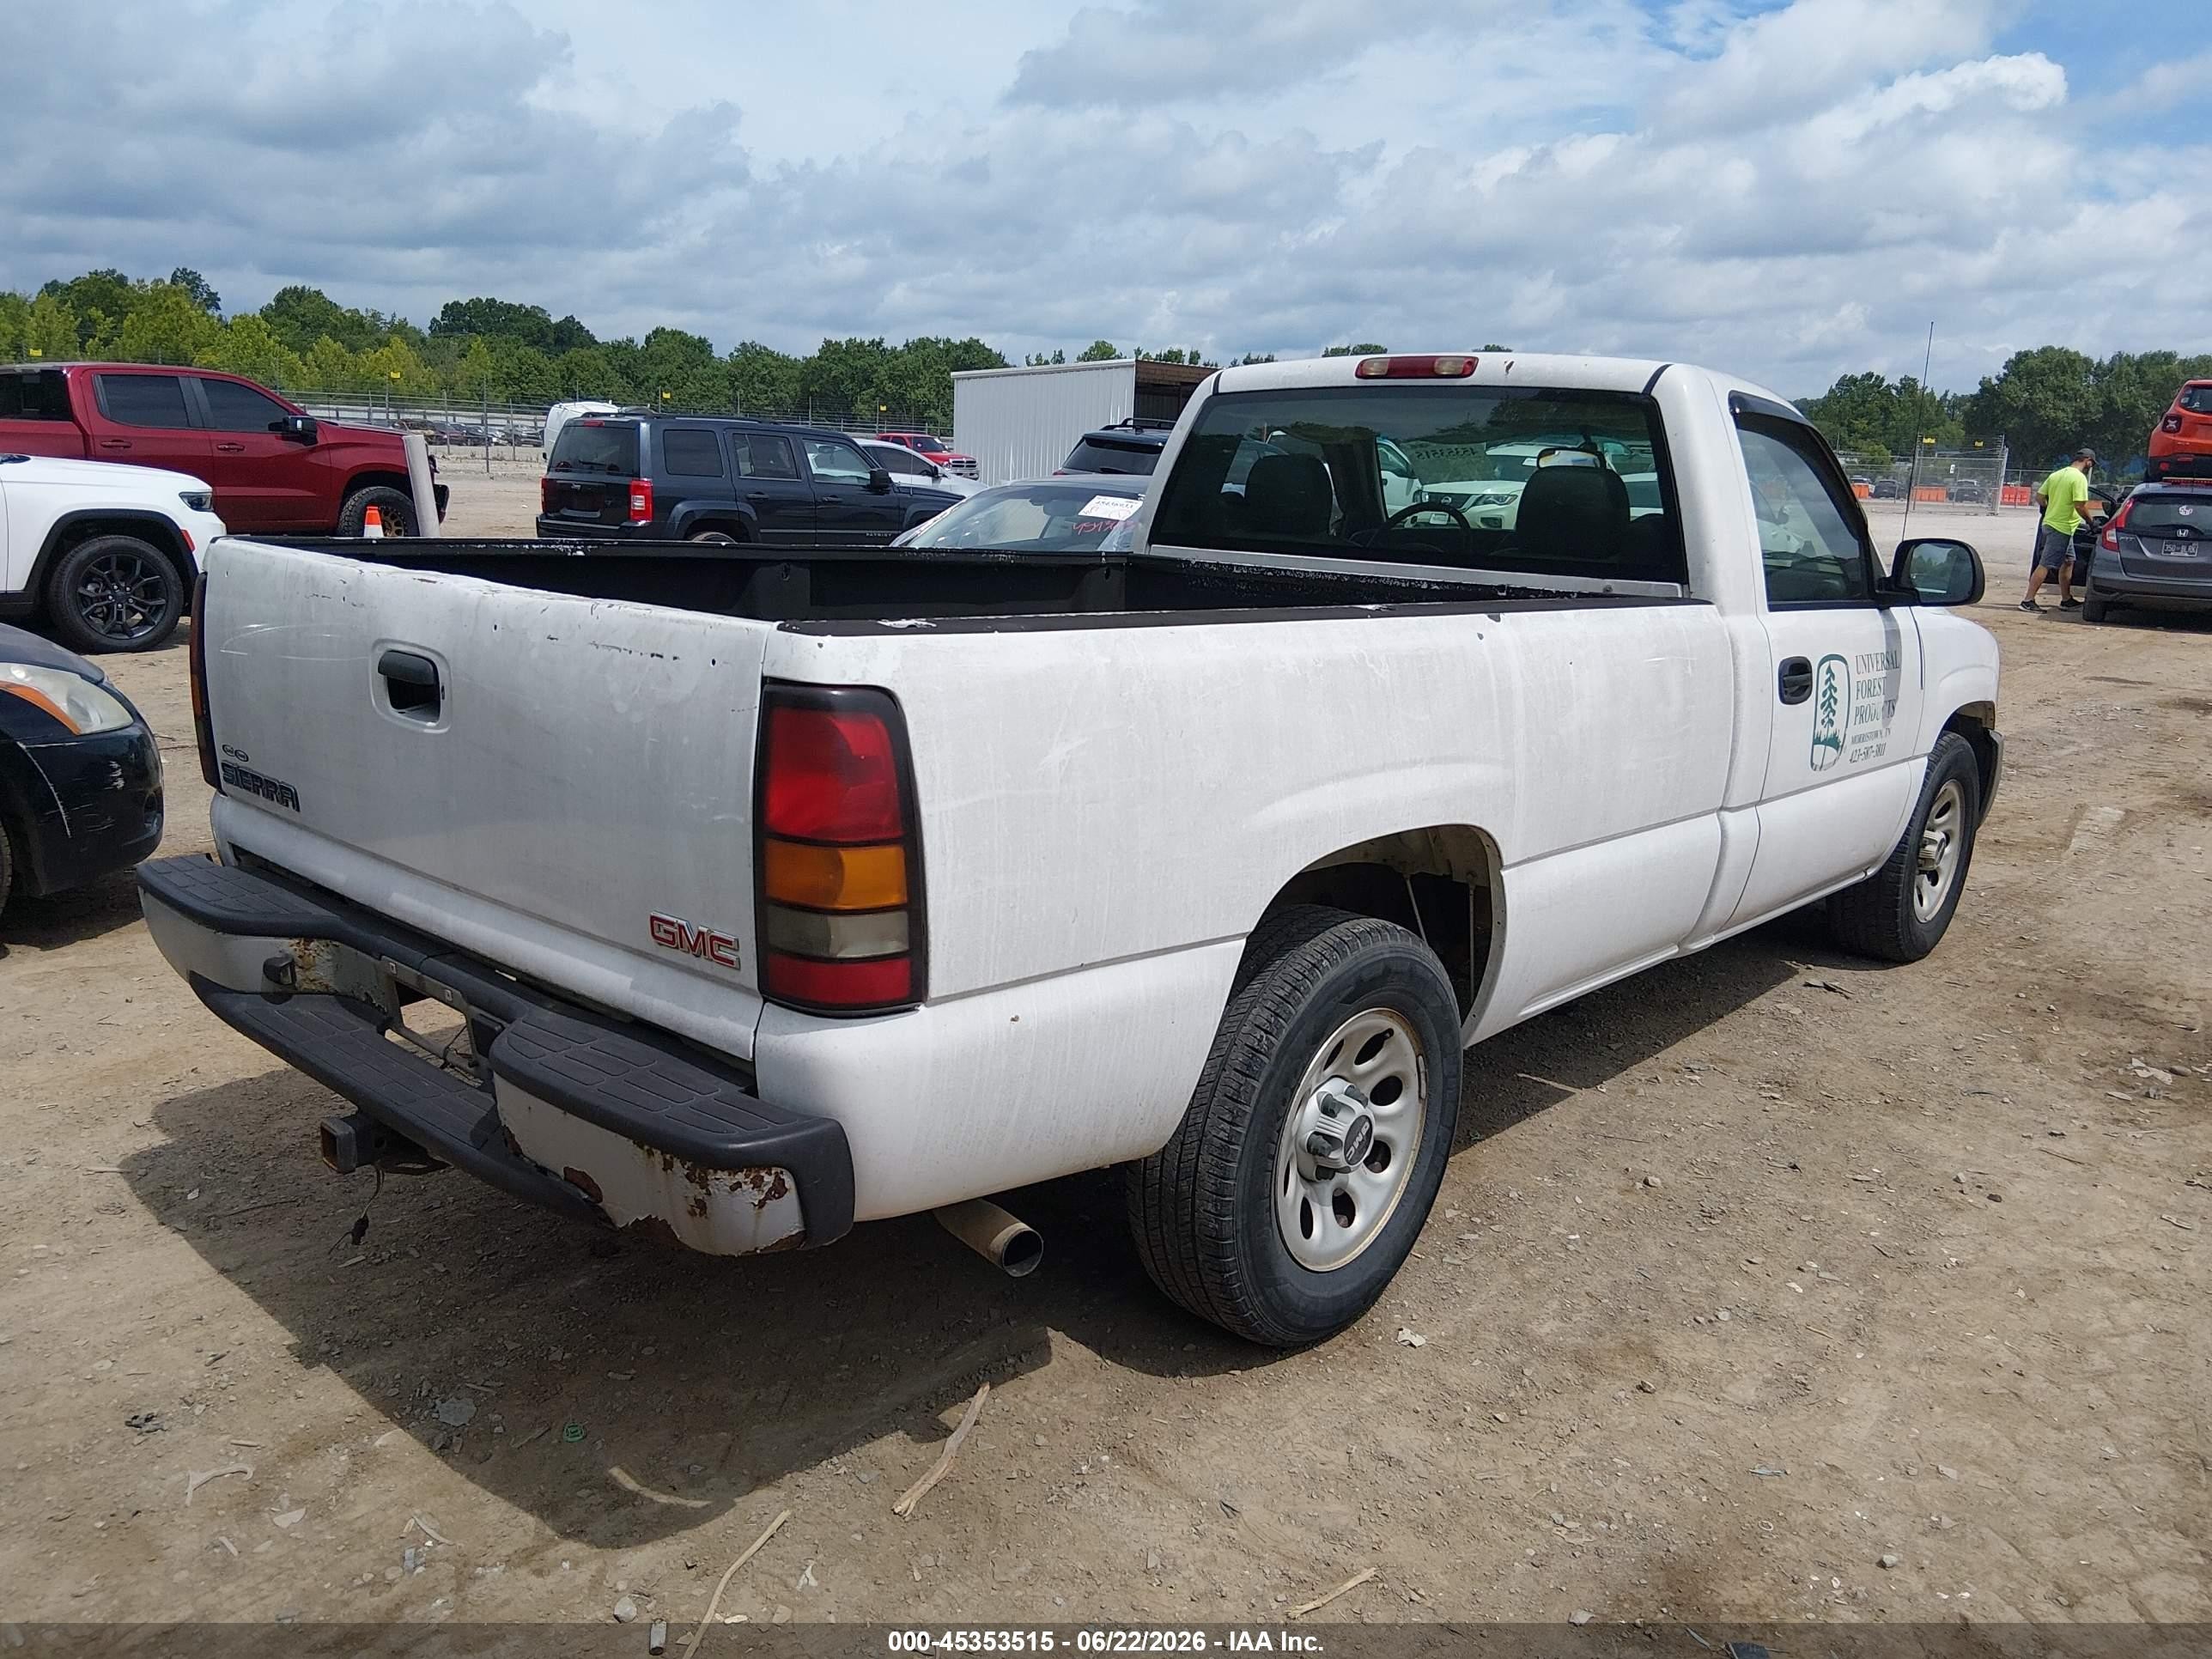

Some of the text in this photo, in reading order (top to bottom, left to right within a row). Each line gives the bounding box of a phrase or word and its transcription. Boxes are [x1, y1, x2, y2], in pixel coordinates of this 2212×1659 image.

[1855, 650, 1900, 675] UNIVERSAL
[1856, 677, 1887, 700] FOREST
[221, 761, 301, 812] SIERRA
[649, 910, 741, 970] GMC
[1346, 1121, 1370, 1161] GMC
